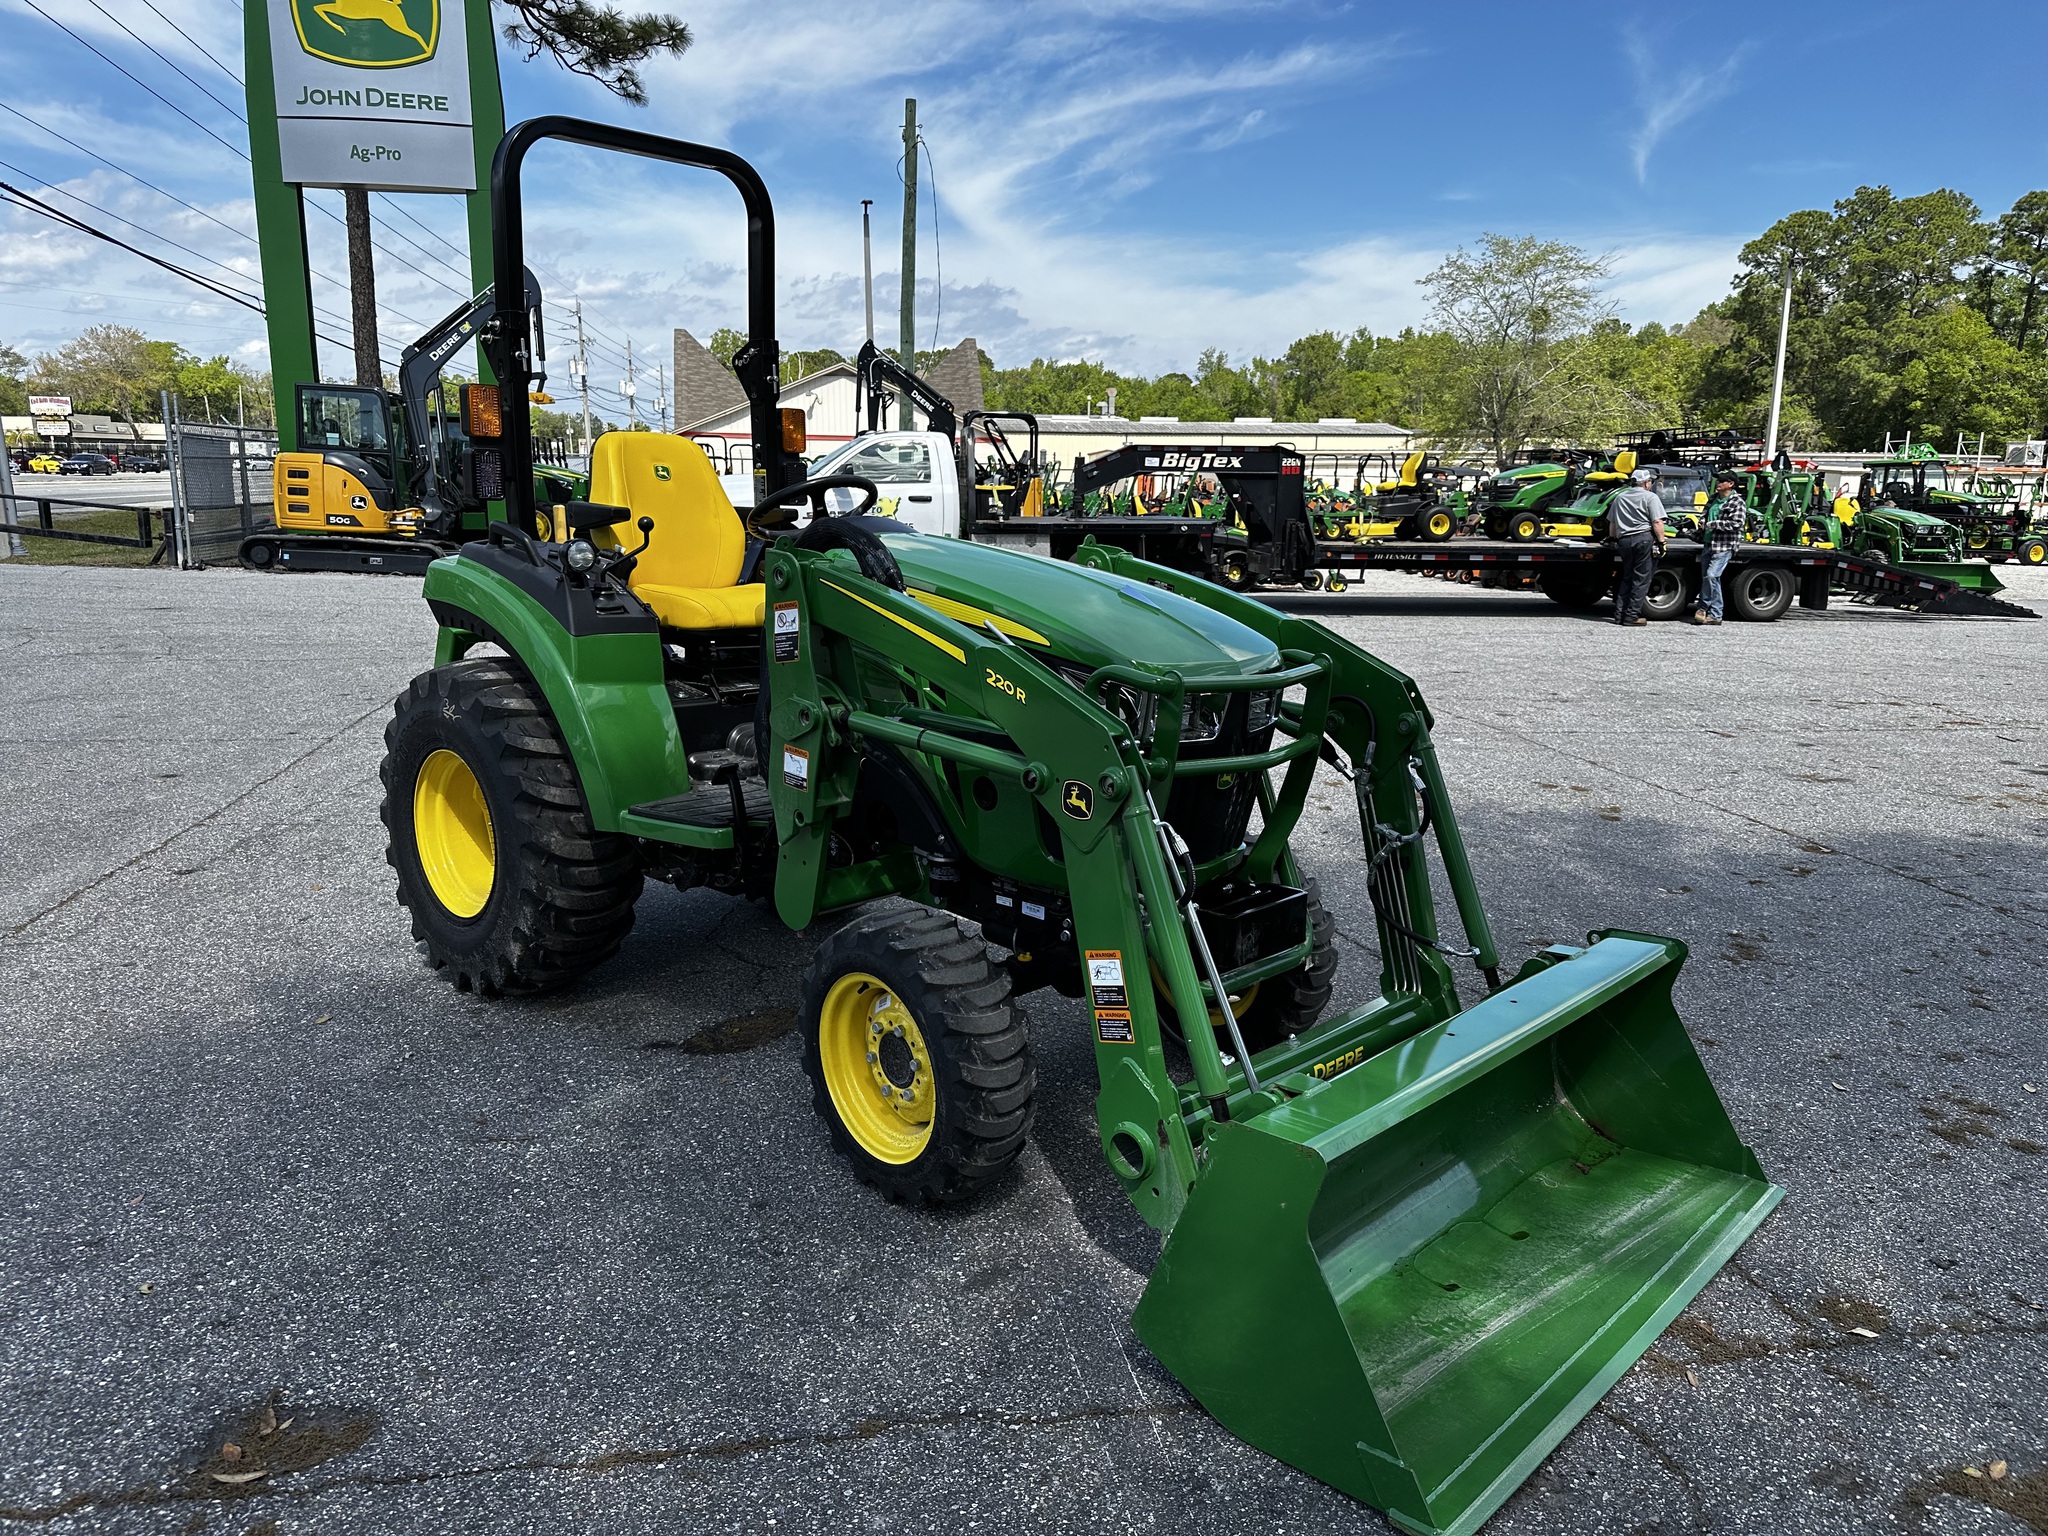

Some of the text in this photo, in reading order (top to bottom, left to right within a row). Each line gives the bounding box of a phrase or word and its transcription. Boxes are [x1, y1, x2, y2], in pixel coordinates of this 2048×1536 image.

[296, 85, 449, 112] JOHN DEERE
[350, 144, 402, 163] Ag-Pro
[429, 332, 461, 361] DEERE
[911, 390, 935, 412] DEERE
[1161, 453, 1244, 471] BigTex
[1281, 466, 1300, 475] HD
[329, 516, 350, 524] 50G
[986, 668, 1026, 705] 220 R
[1313, 1045, 1364, 1079] DEERE
